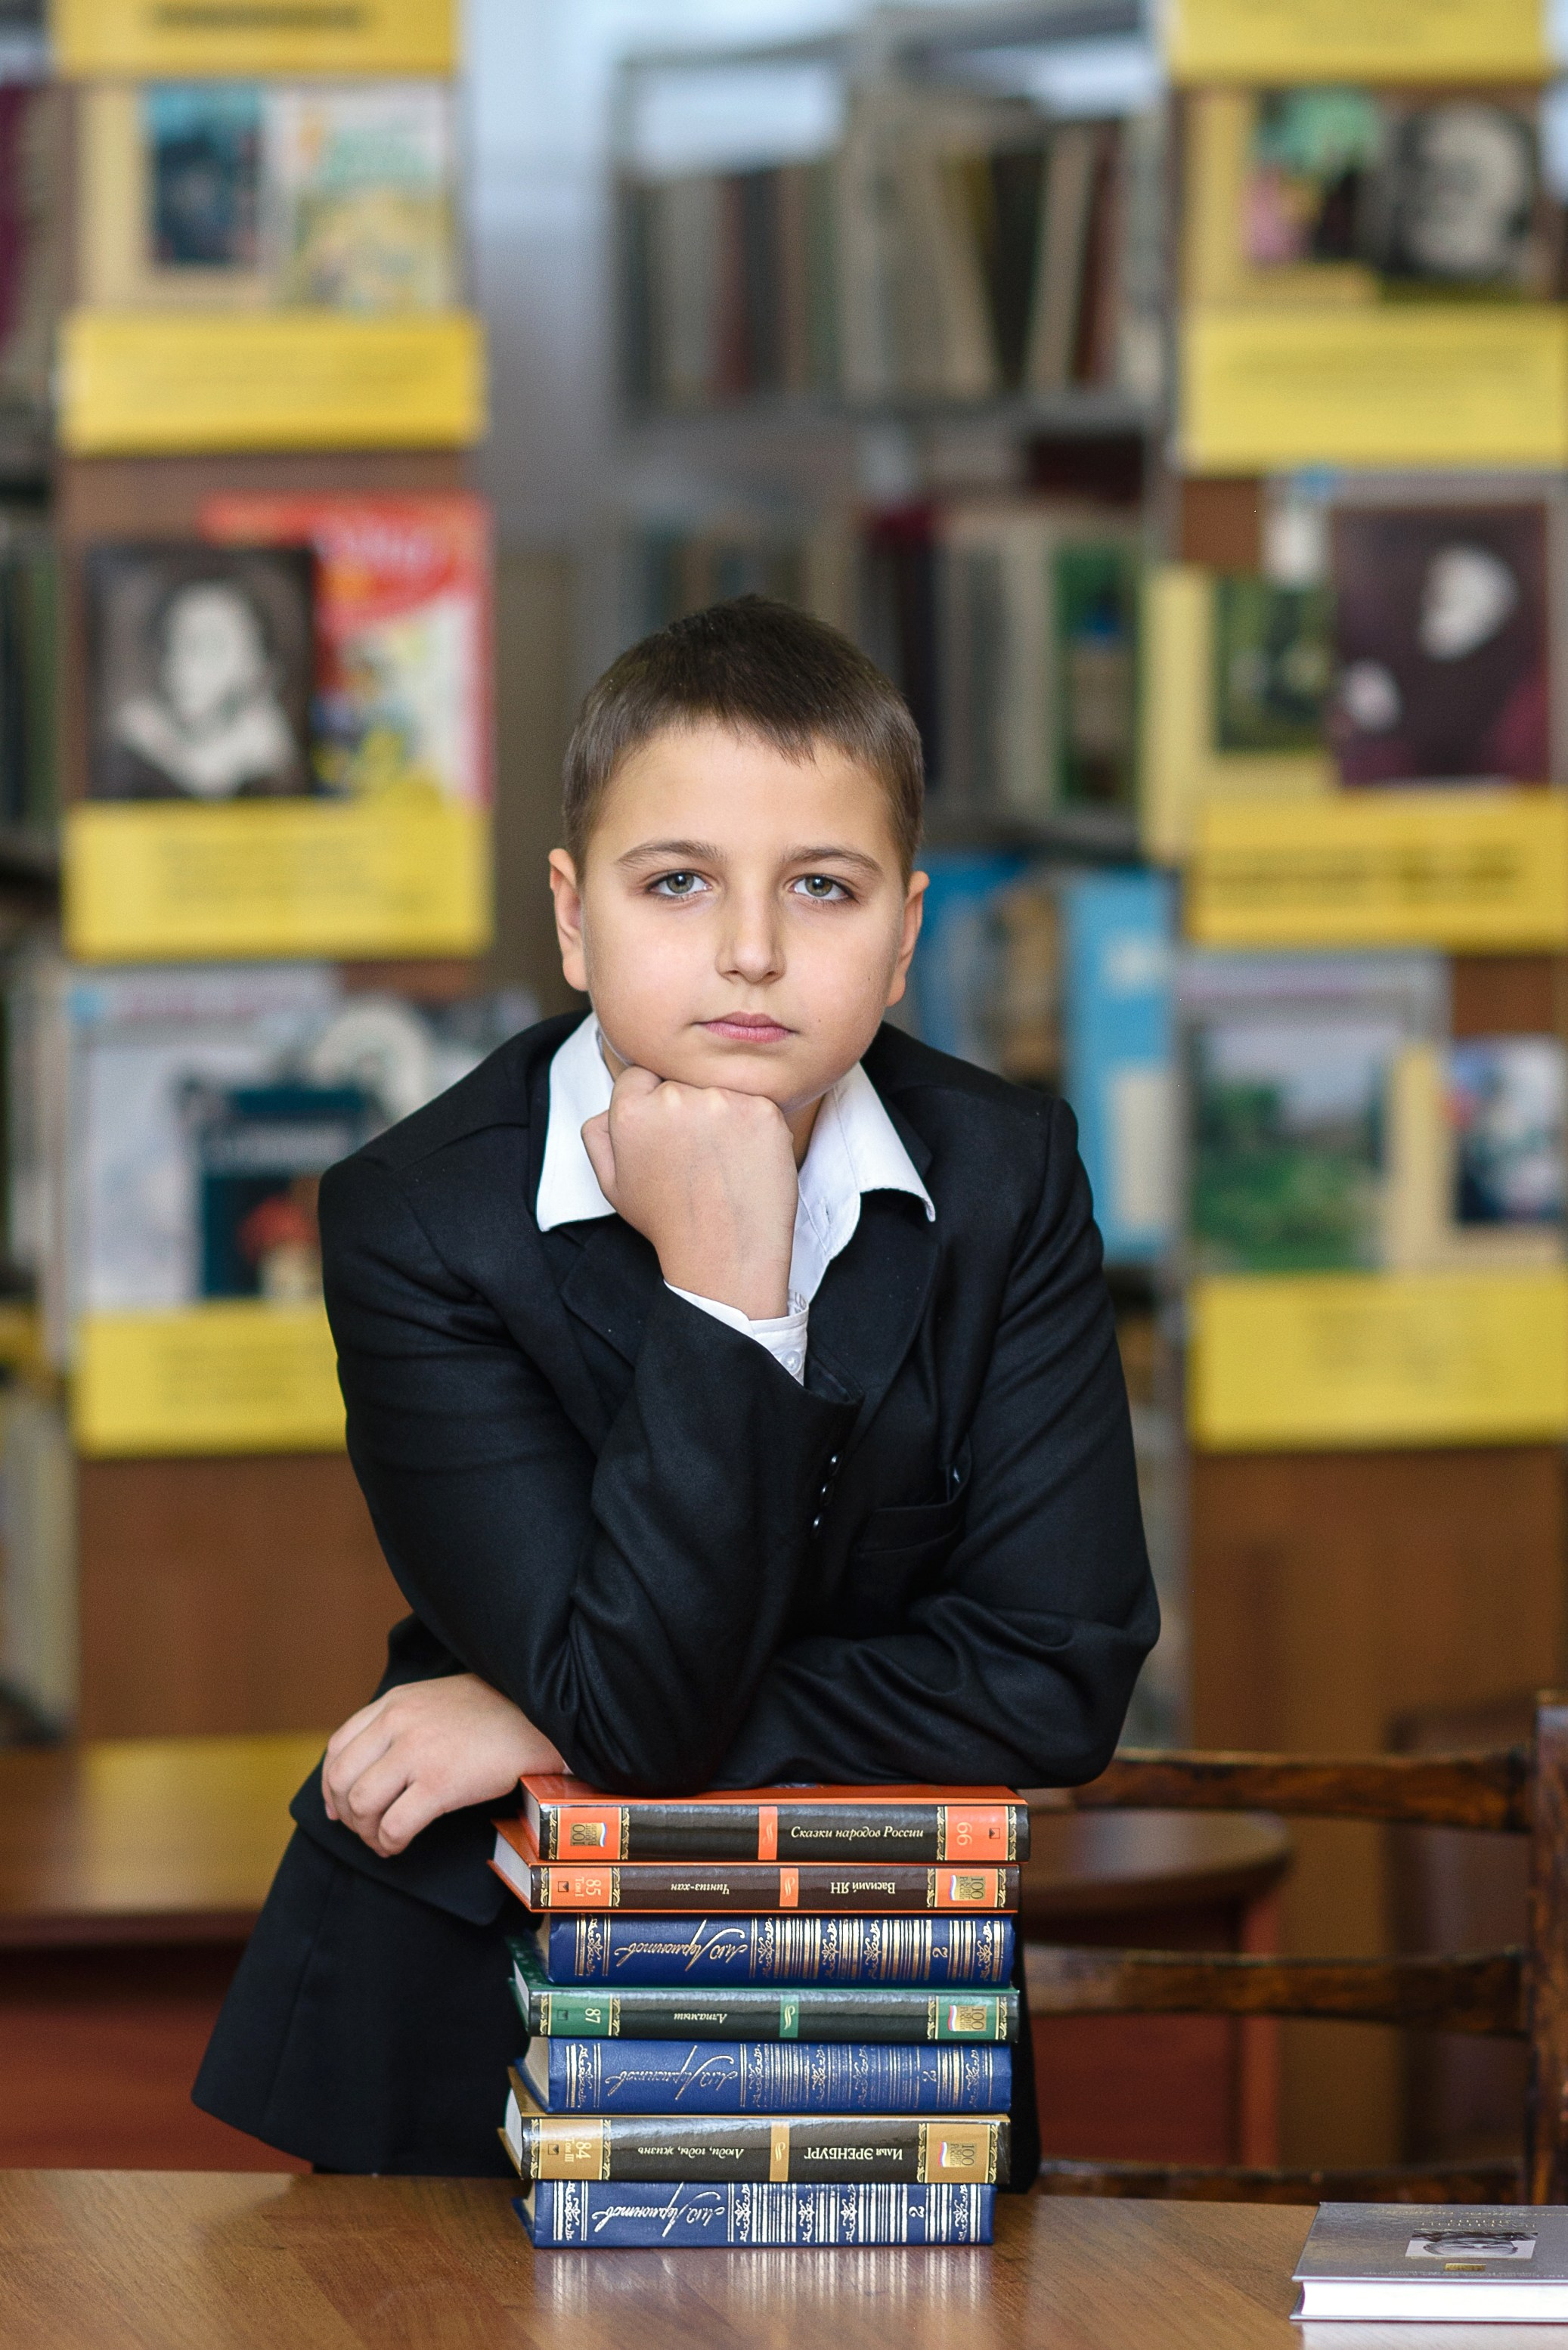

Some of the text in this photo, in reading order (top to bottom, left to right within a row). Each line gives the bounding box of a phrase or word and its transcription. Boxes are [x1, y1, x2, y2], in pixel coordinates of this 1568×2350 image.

[572, 1824, 586, 1846] 100
[790, 1825, 924, 1841] Сказки народов России
[585, 1878, 602, 1896] 85
[670, 1882, 730, 1896] Чингиз-хан
[830, 1881, 896, 1895] Василий ЯН
[970, 1877, 984, 1899] 100
[614, 1918, 745, 1971] Лермонтов
[584, 2007, 601, 2024] 87
[673, 2012, 728, 2024] Алпамыш
[971, 2007, 985, 2030] 100
[575, 2141, 592, 2159] 84
[637, 2145, 745, 2159] Люди, годы, жизнь
[804, 2147, 903, 2160] Илья ЭРЕНБУРГ
[961, 2144, 975, 2166] 100
[591, 2181, 721, 2237] Лермонтов
